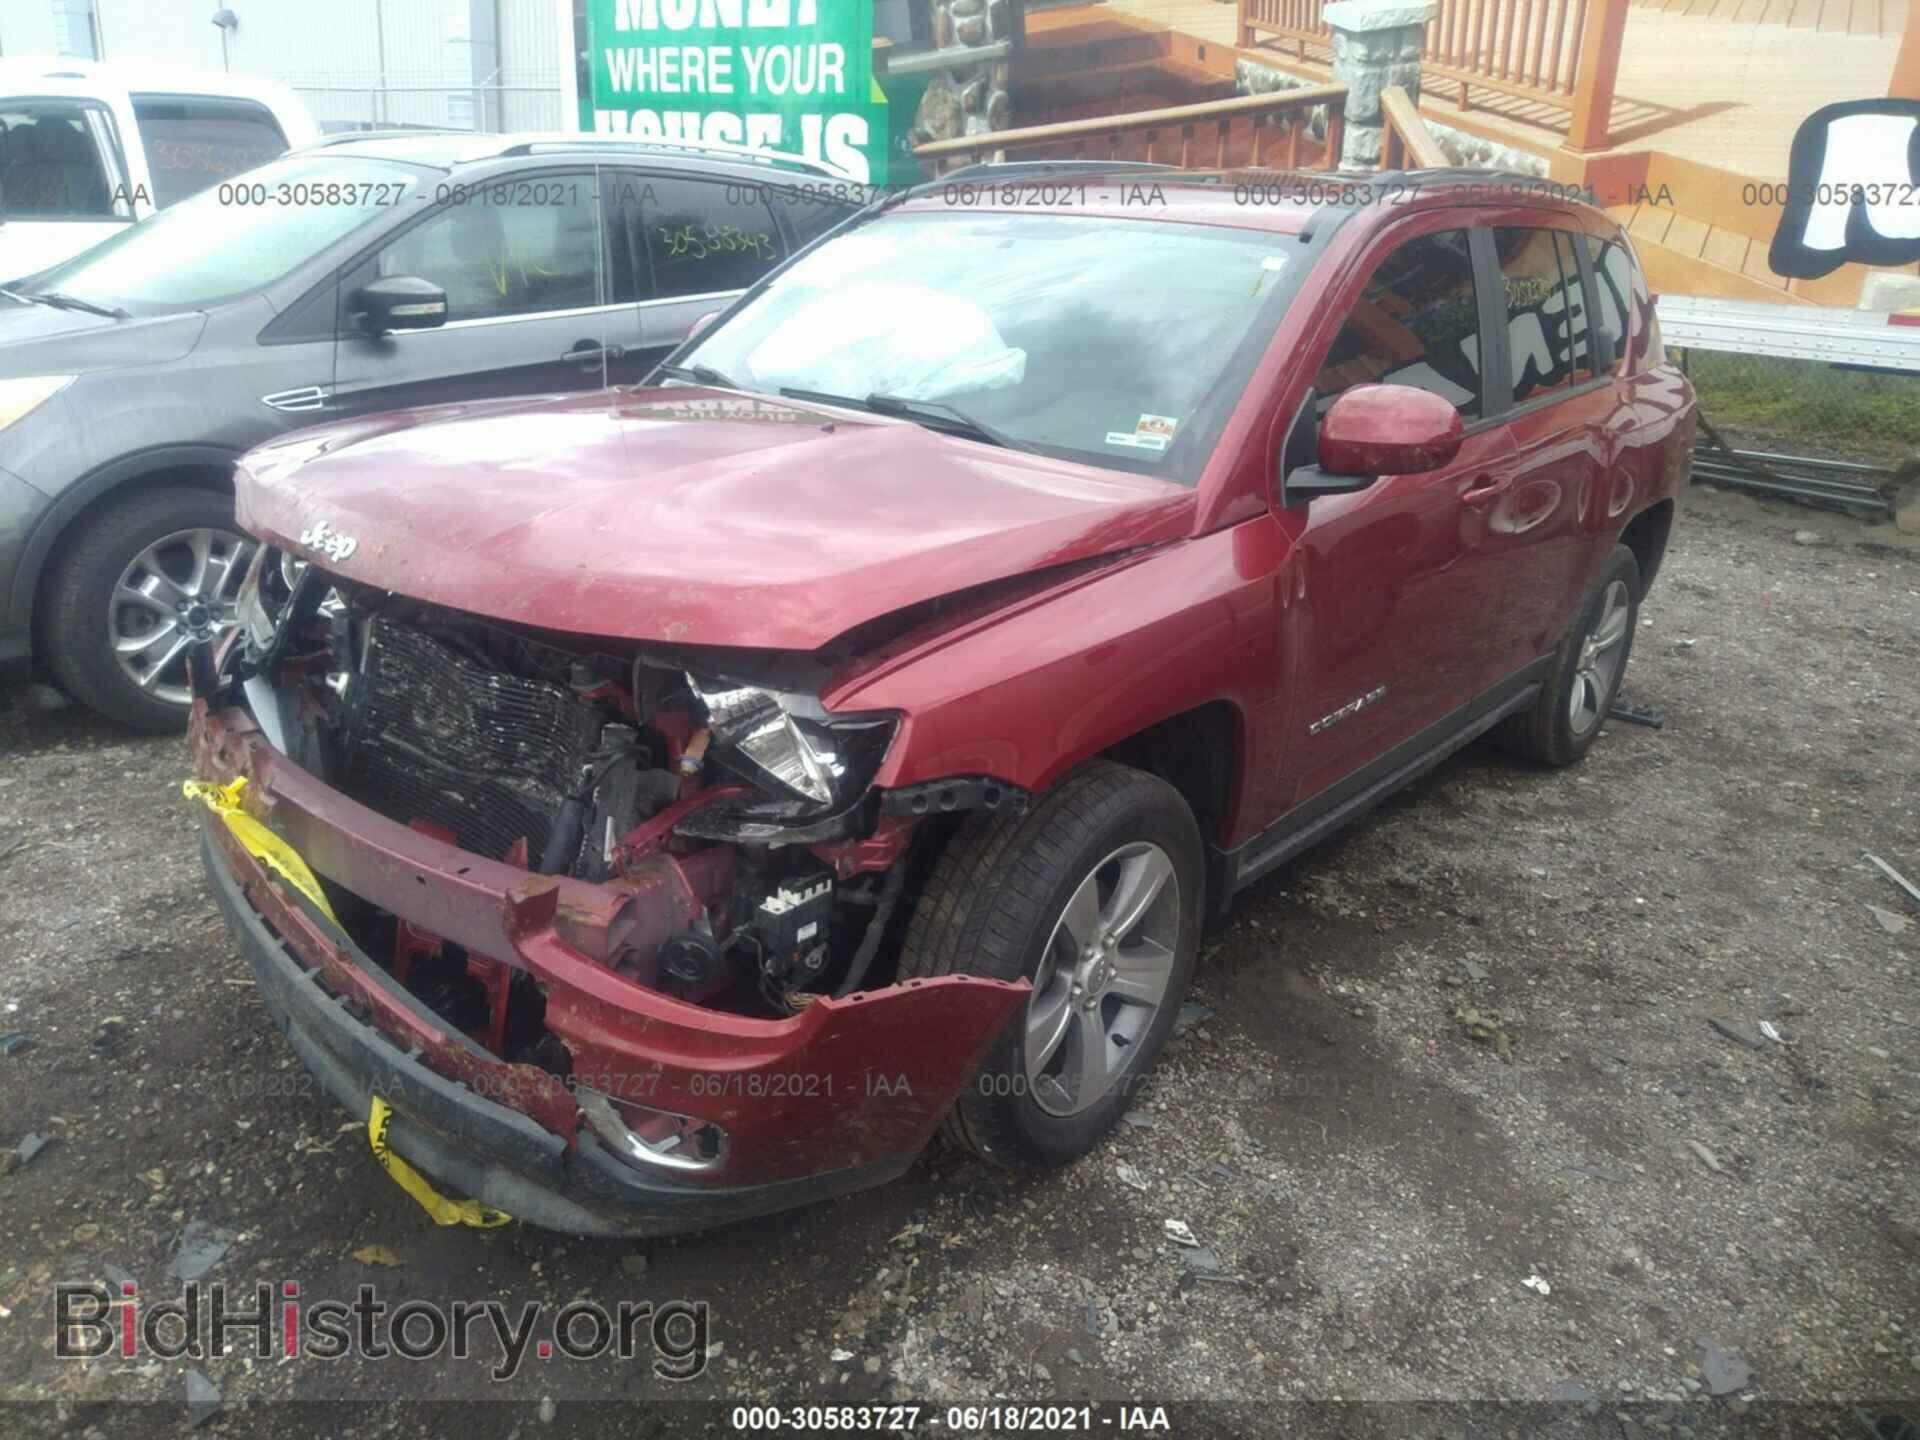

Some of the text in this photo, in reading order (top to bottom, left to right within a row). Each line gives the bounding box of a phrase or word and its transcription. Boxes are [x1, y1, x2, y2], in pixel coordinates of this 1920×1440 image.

[606, 43, 846, 94] WHERE YOUR
[300, 520, 357, 563] Jeep
